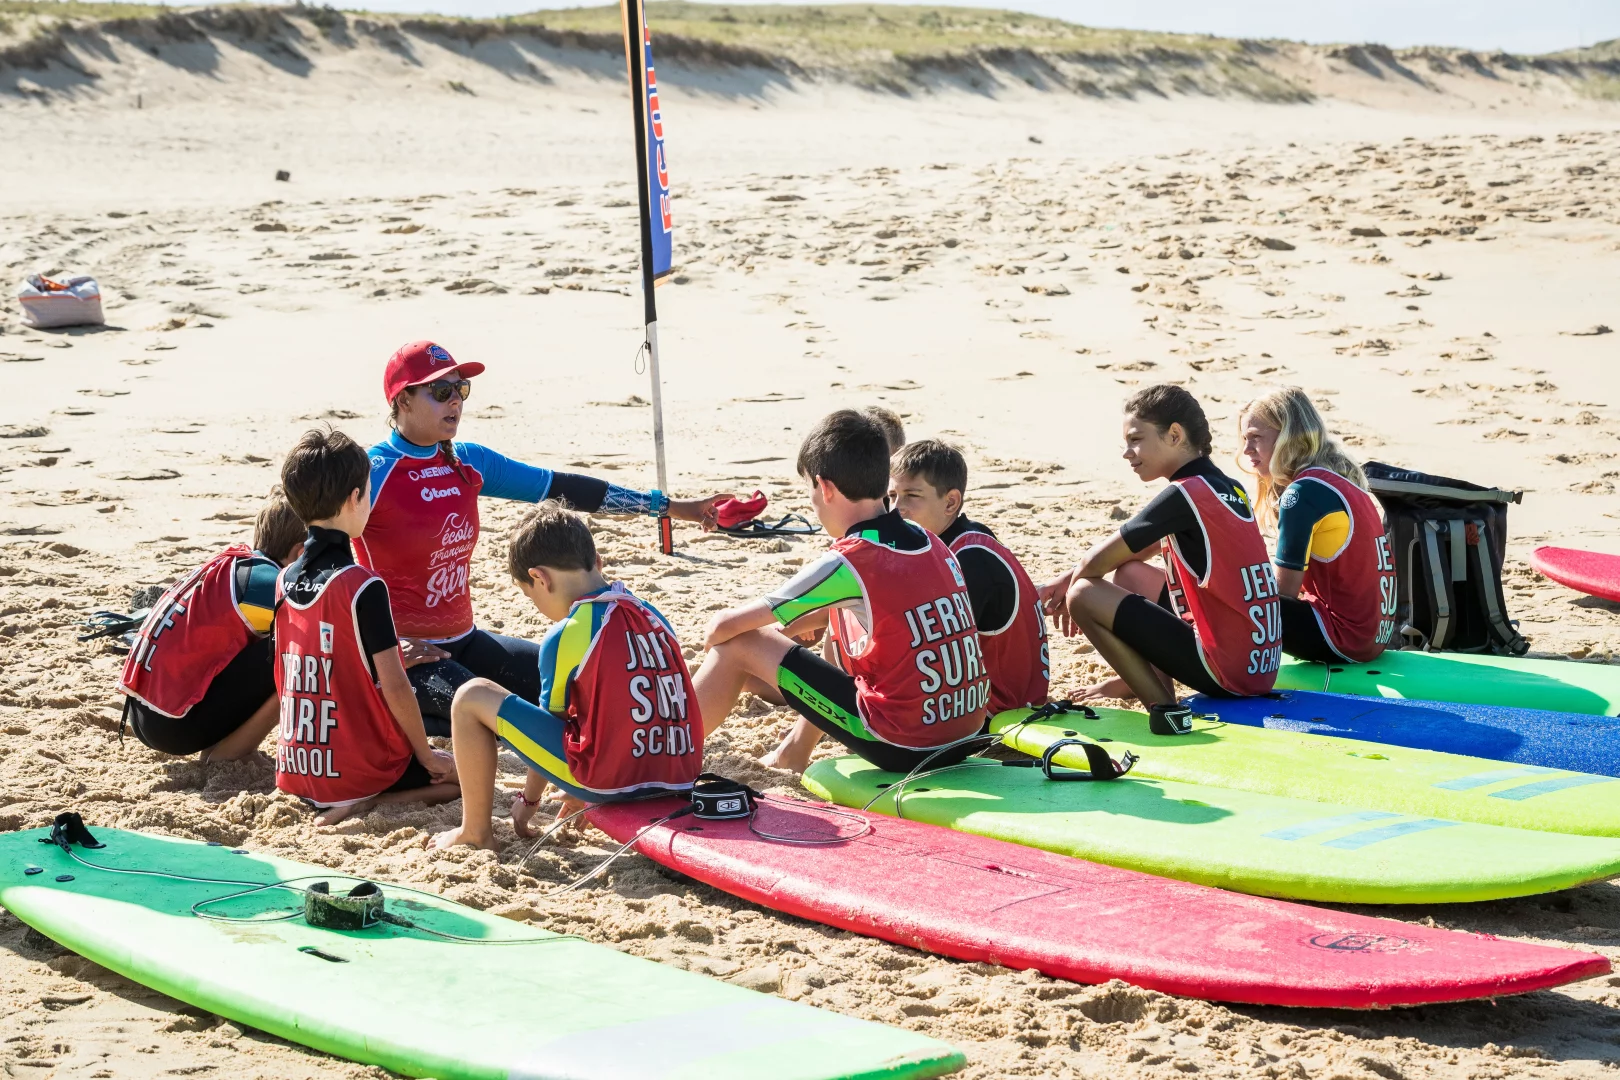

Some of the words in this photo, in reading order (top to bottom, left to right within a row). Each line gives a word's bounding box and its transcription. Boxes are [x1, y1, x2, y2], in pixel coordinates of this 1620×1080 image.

[295, 581, 324, 592] CUR
[1240, 561, 1279, 602] JER
[1380, 574, 1398, 616] SU
[281, 653, 333, 696] RRY
[280, 695, 338, 745] URF
[277, 744, 341, 778] CHOOL
